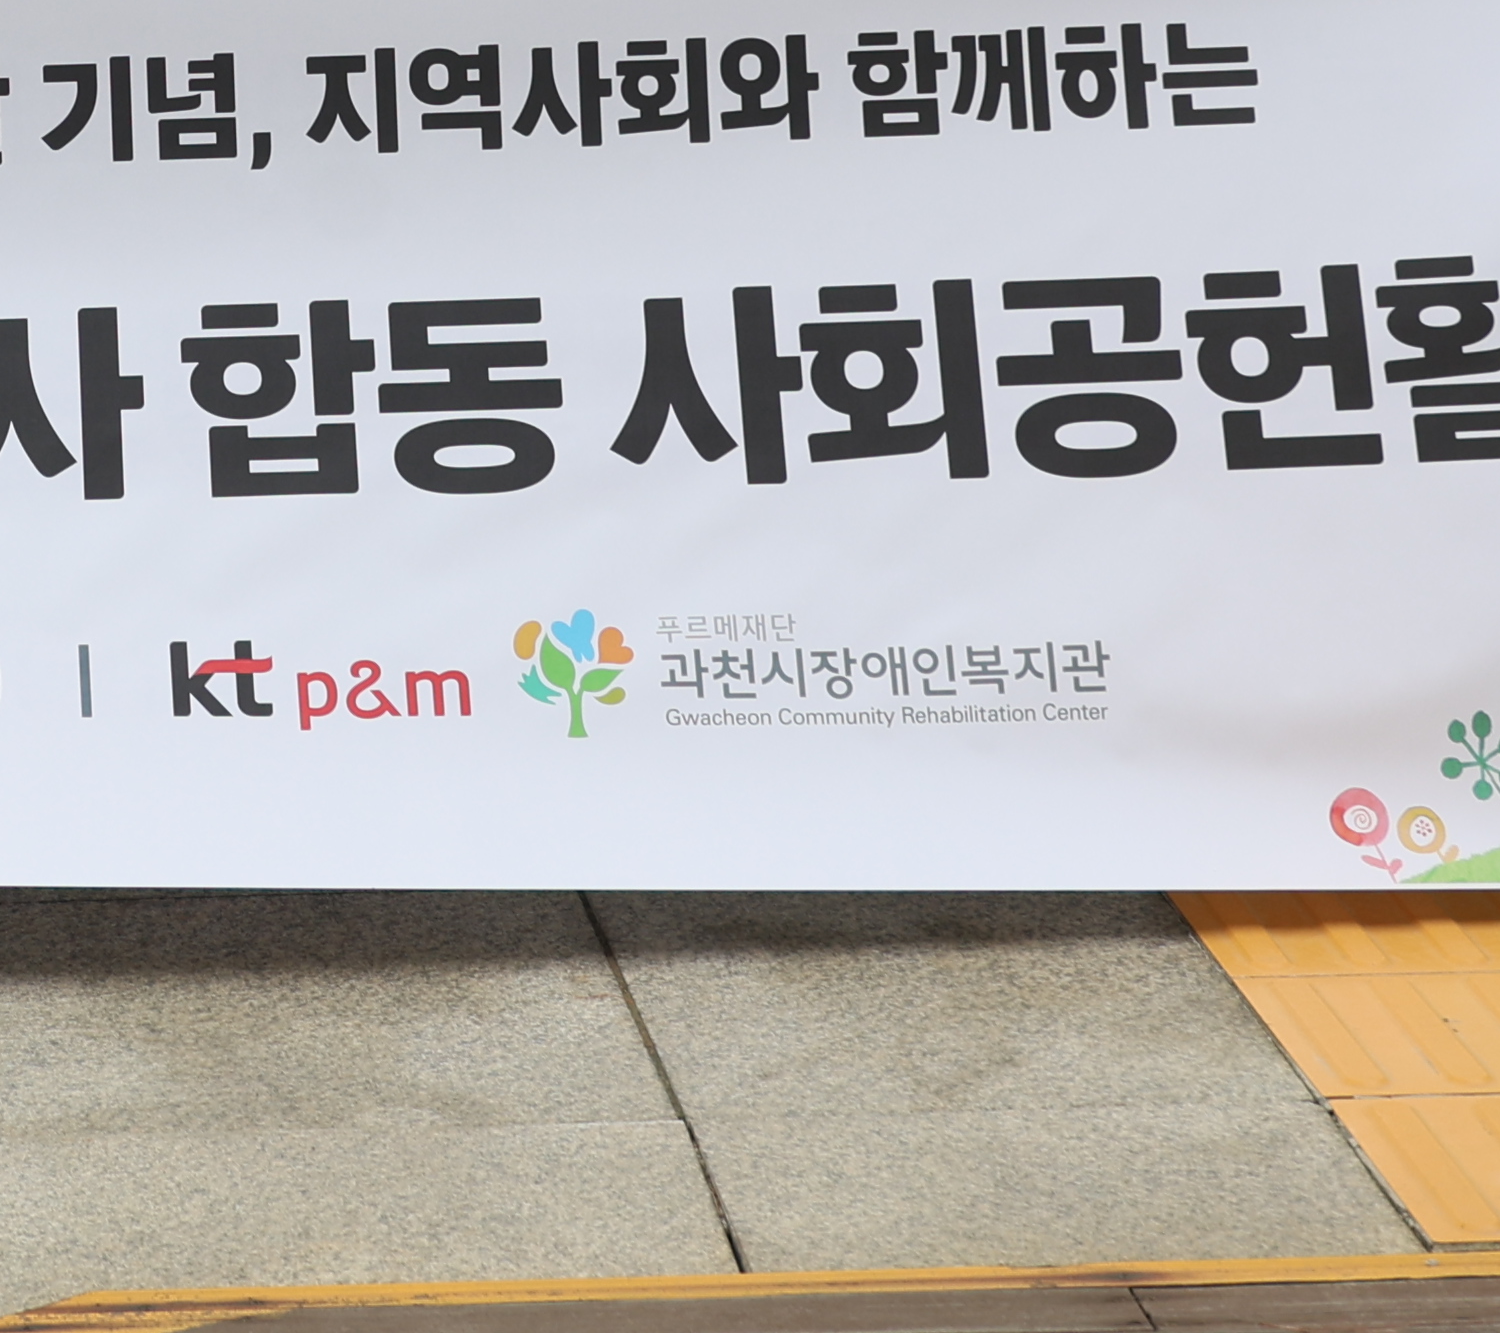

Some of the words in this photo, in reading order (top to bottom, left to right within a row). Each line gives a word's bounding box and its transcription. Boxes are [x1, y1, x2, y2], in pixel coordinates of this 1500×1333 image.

[41, 50, 277, 175] 기념,
[304, 35, 820, 154] 지역사회와
[845, 21, 1261, 138] 함께하는
[179, 296, 564, 498] 합동
[656, 613, 796, 643] 푸르메재단
[169, 640, 273, 716] kt
[297, 660, 472, 731] p&m
[660, 640, 1110, 699] 과천시장애인복지관
[665, 708, 772, 726] Gwacheon
[778, 706, 895, 729] Community
[902, 704, 1036, 724] Rehabilitation
[1043, 703, 1108, 722] Center
